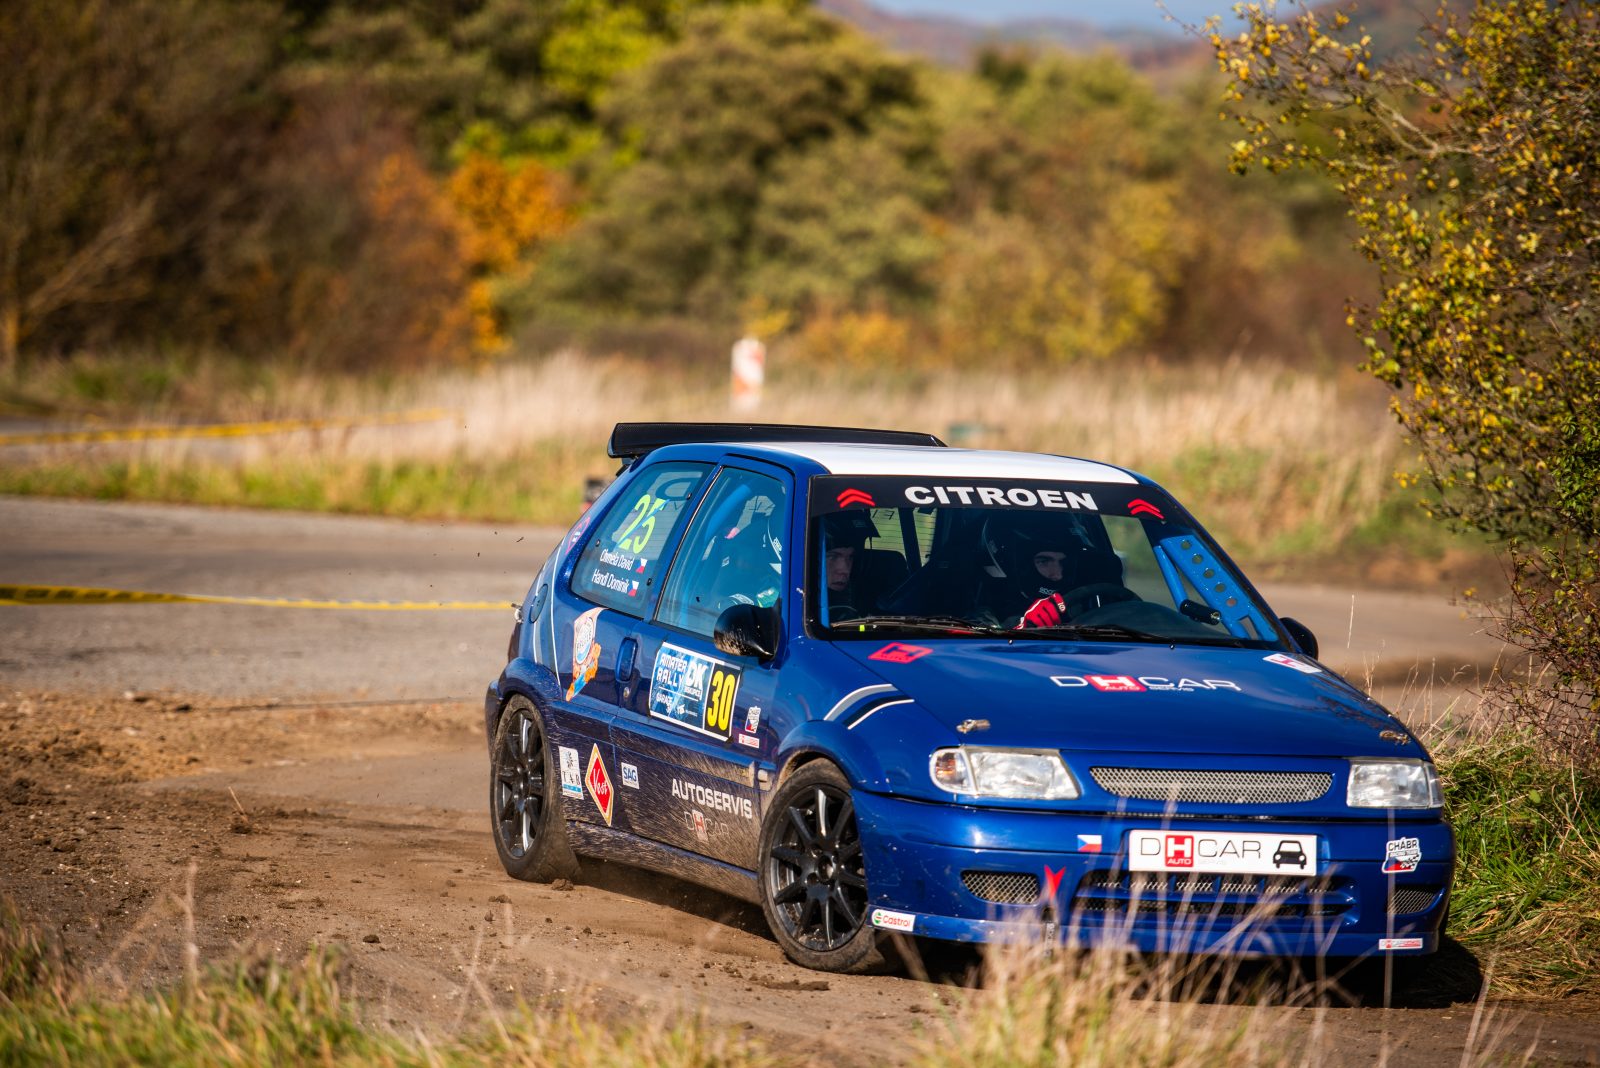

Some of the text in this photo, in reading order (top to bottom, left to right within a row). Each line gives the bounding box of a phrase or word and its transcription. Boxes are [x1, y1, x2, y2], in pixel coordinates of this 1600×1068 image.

[905, 486, 1098, 510] CITROEN
[617, 494, 667, 554] 25
[618, 555, 635, 571] David
[607, 574, 629, 594] Dominik
[656, 666, 685, 692] RALLY
[685, 661, 709, 689] DK
[707, 670, 736, 731] 30
[623, 766, 637, 782] SAG
[671, 778, 753, 820] AUTOSERVIS
[882, 915, 911, 927] Castrol
